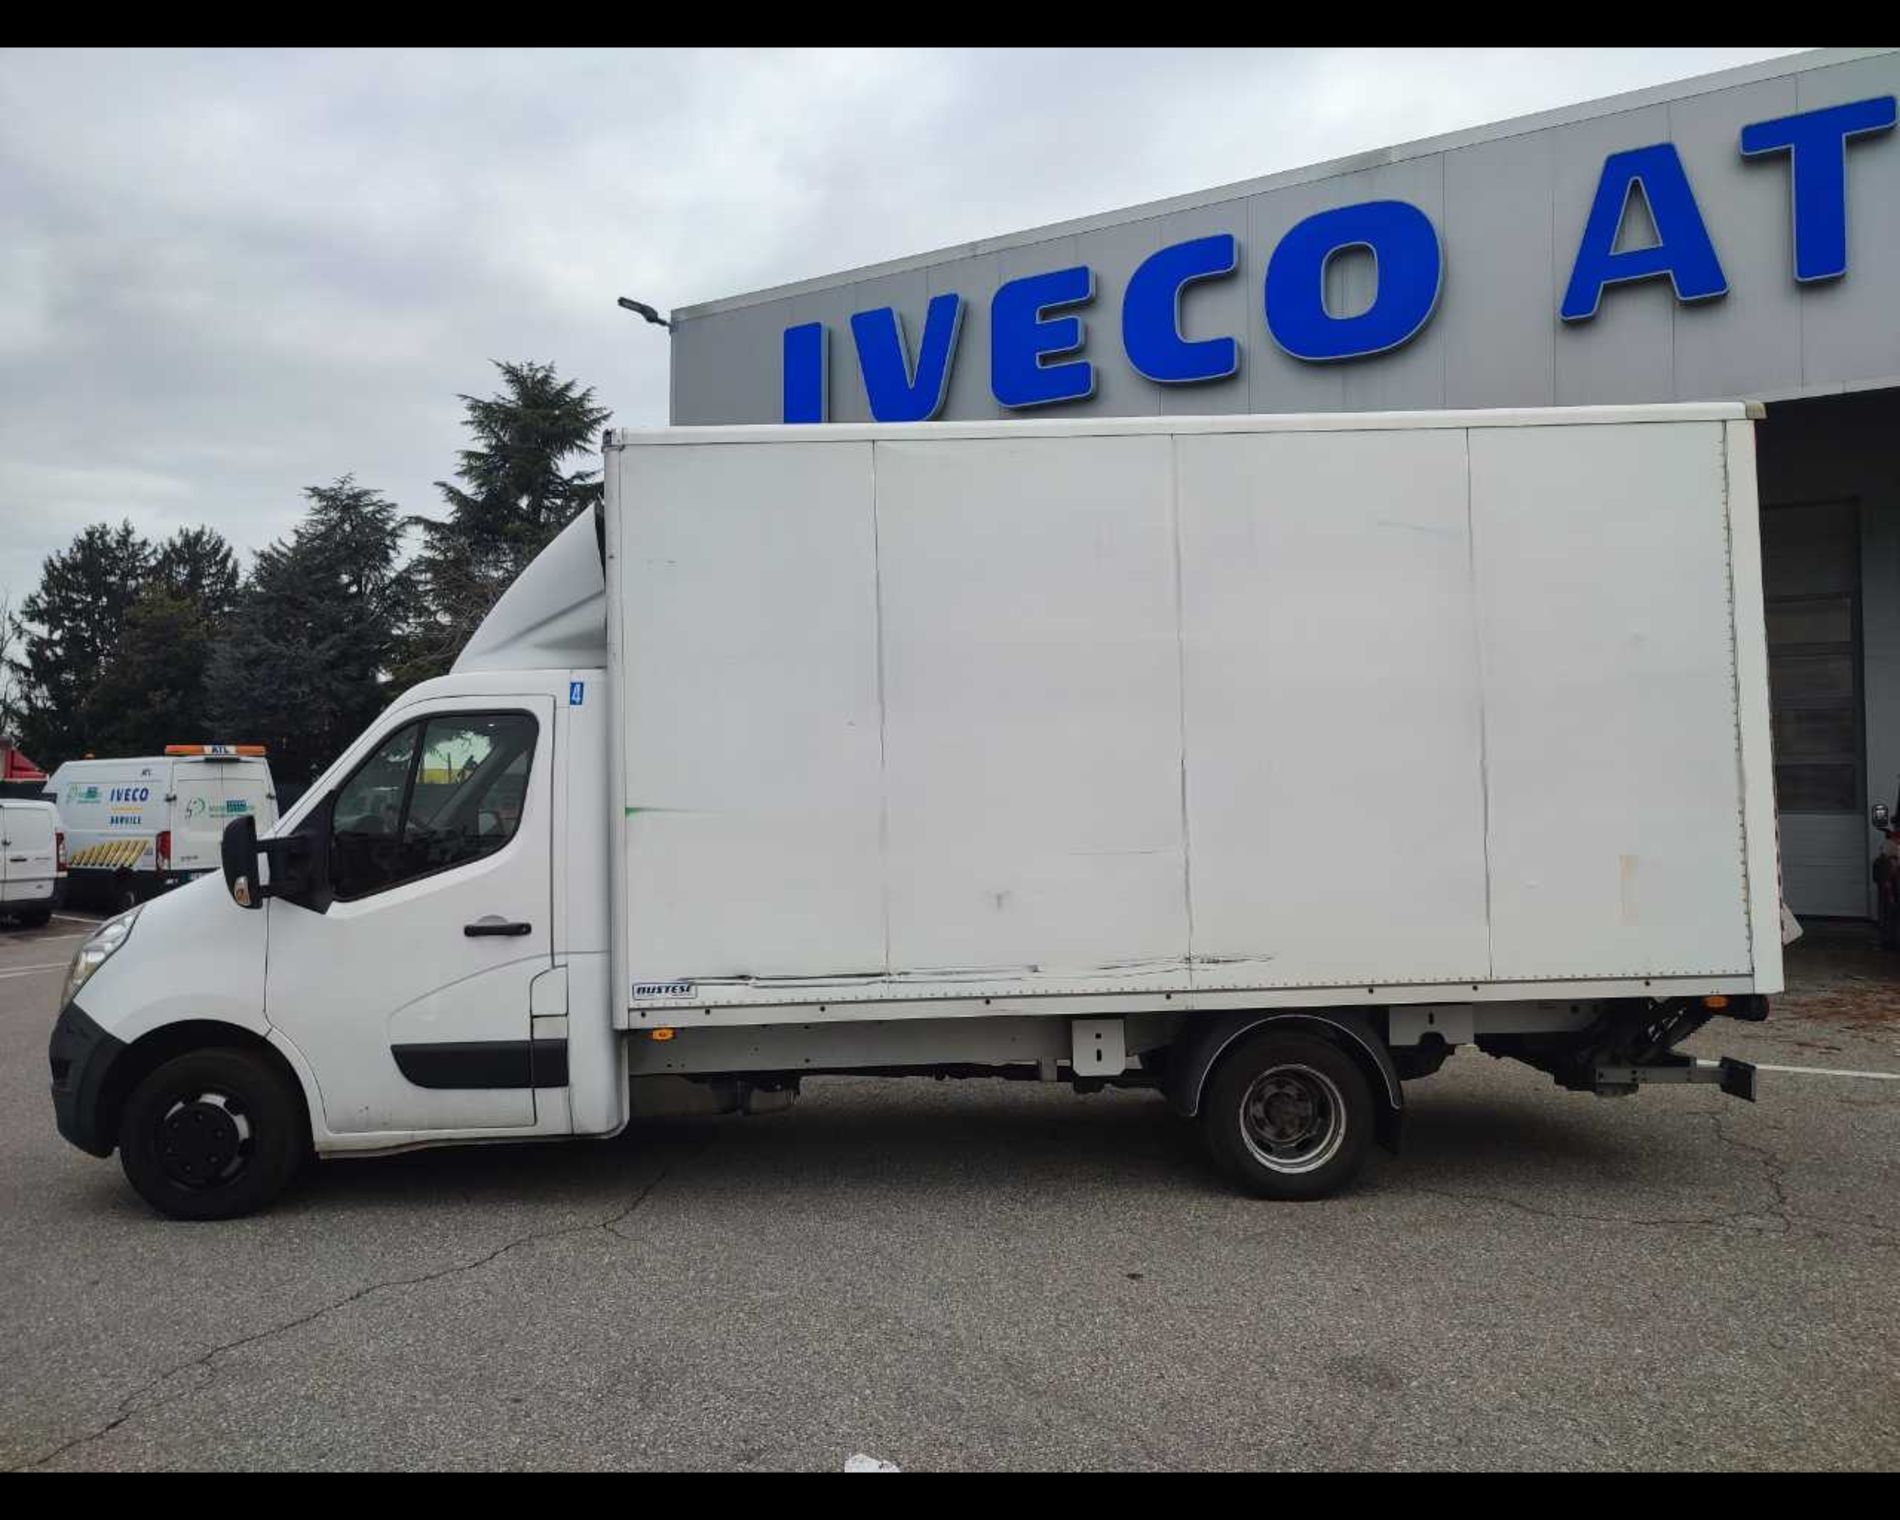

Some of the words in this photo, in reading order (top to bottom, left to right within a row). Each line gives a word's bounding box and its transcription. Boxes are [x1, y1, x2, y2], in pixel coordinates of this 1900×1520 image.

[783, 199, 1442, 424] IVECO
[1559, 95, 1897, 321] AT
[571, 683, 581, 703] 4
[110, 787, 149, 802] IVECO
